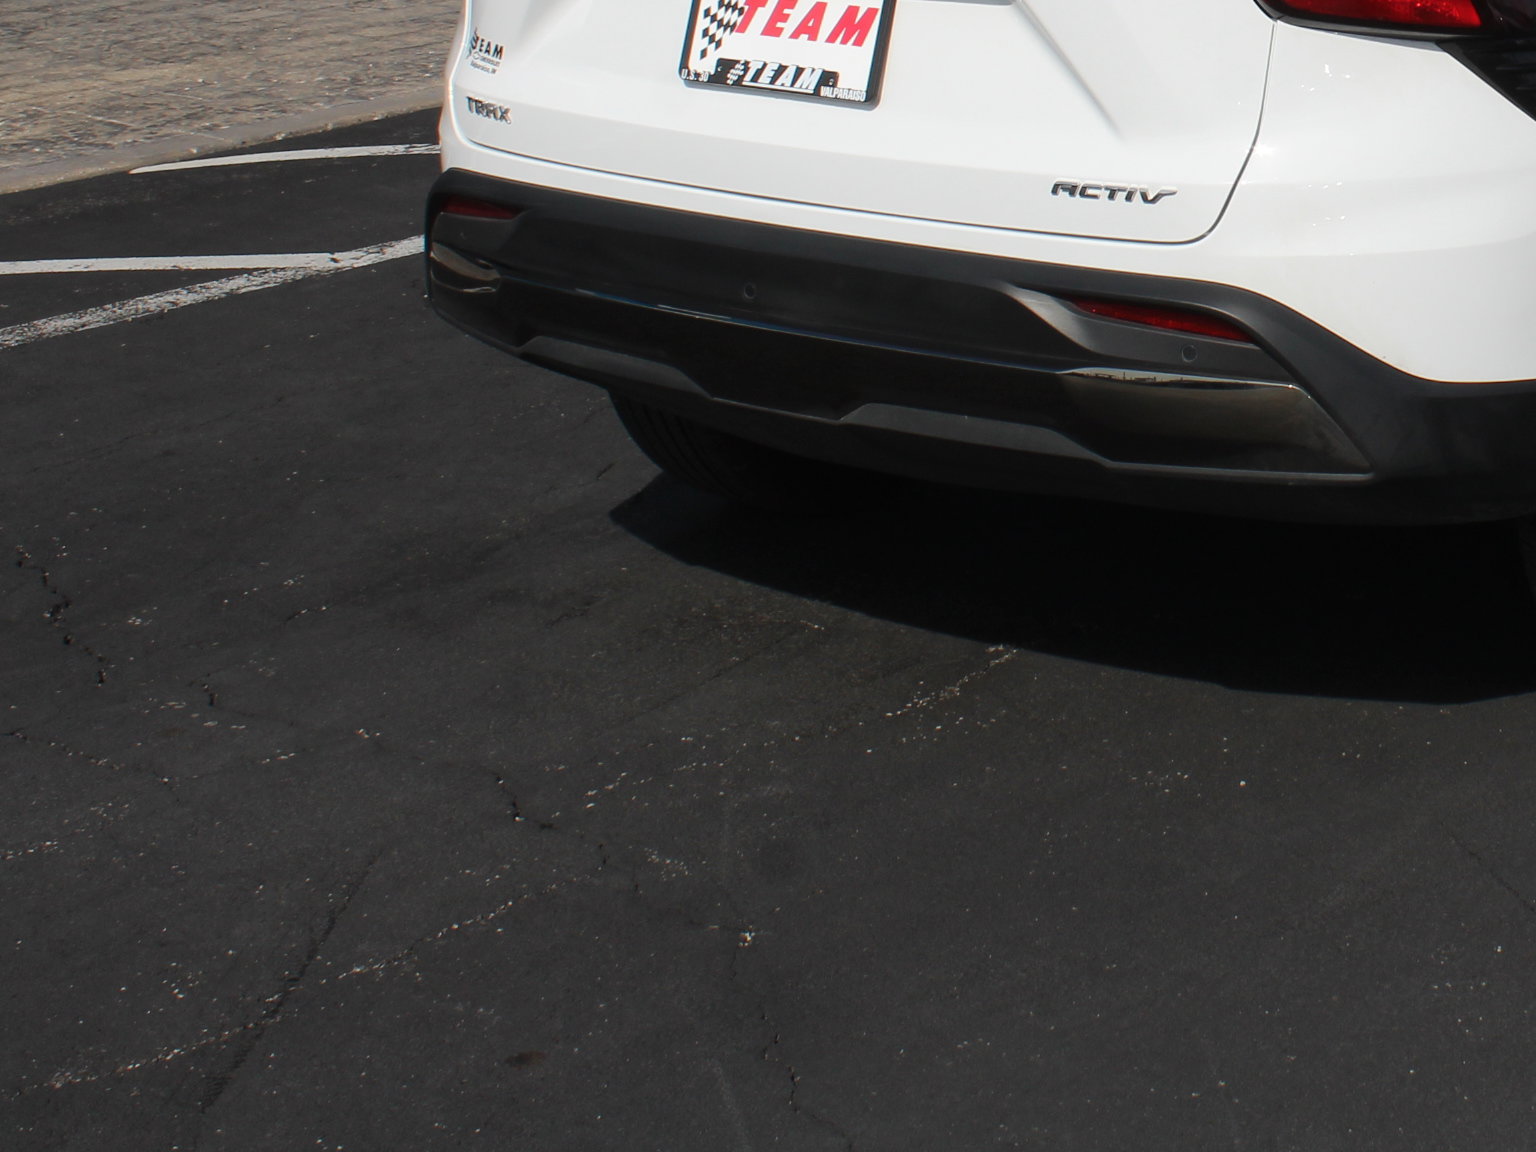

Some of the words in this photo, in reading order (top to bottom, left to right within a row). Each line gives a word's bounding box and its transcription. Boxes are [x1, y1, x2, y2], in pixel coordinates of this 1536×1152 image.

[472, 35, 504, 60] TEAM
[681, 68, 697, 81] U.S.
[742, 59, 825, 90] TEAM
[820, 86, 867, 102] VALPARAISO
[1050, 179, 1179, 205] ACTIV
